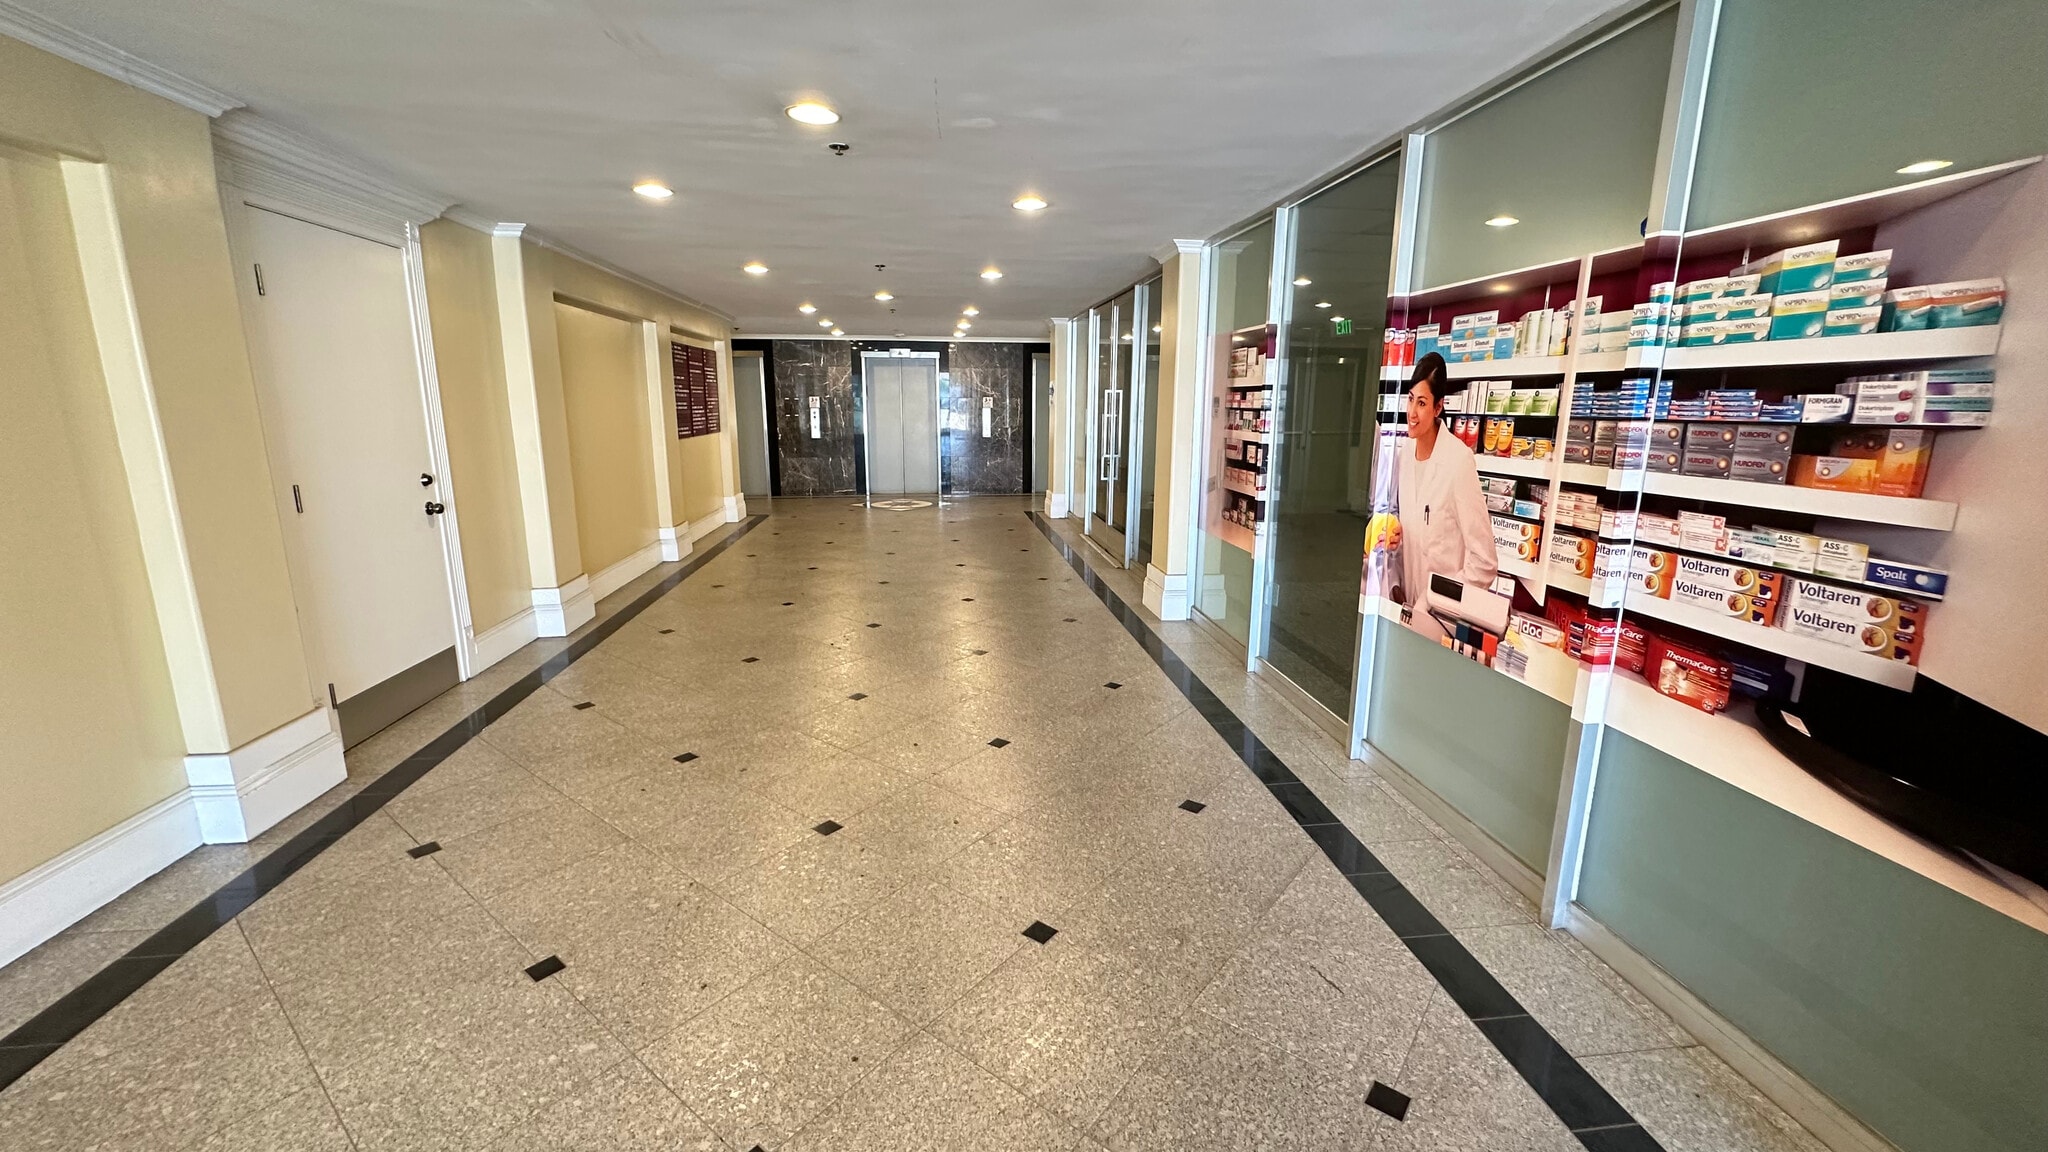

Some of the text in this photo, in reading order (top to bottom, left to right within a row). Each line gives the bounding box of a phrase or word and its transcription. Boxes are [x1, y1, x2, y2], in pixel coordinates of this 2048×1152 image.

[1336, 319, 1352, 335] EXIT
[1617, 451, 1642, 459] NUROFEN
[1734, 460, 1766, 468] NUROFEN
[1493, 517, 1520, 530] Voltaren
[1493, 536, 1517, 549] oltaren
[1596, 544, 1626, 555] oltaren
[1592, 565, 1622, 578] oltaren
[1680, 556, 1730, 577] Voltaren
[1876, 566, 1908, 580] Spalt
[1675, 579, 1724, 602] Voltaren
[1798, 581, 1862, 606] Voltaren
[1793, 608, 1856, 635] Voltaren
[1522, 621, 1542, 639] doc
[1666, 649, 1718, 674] ThermaCare
